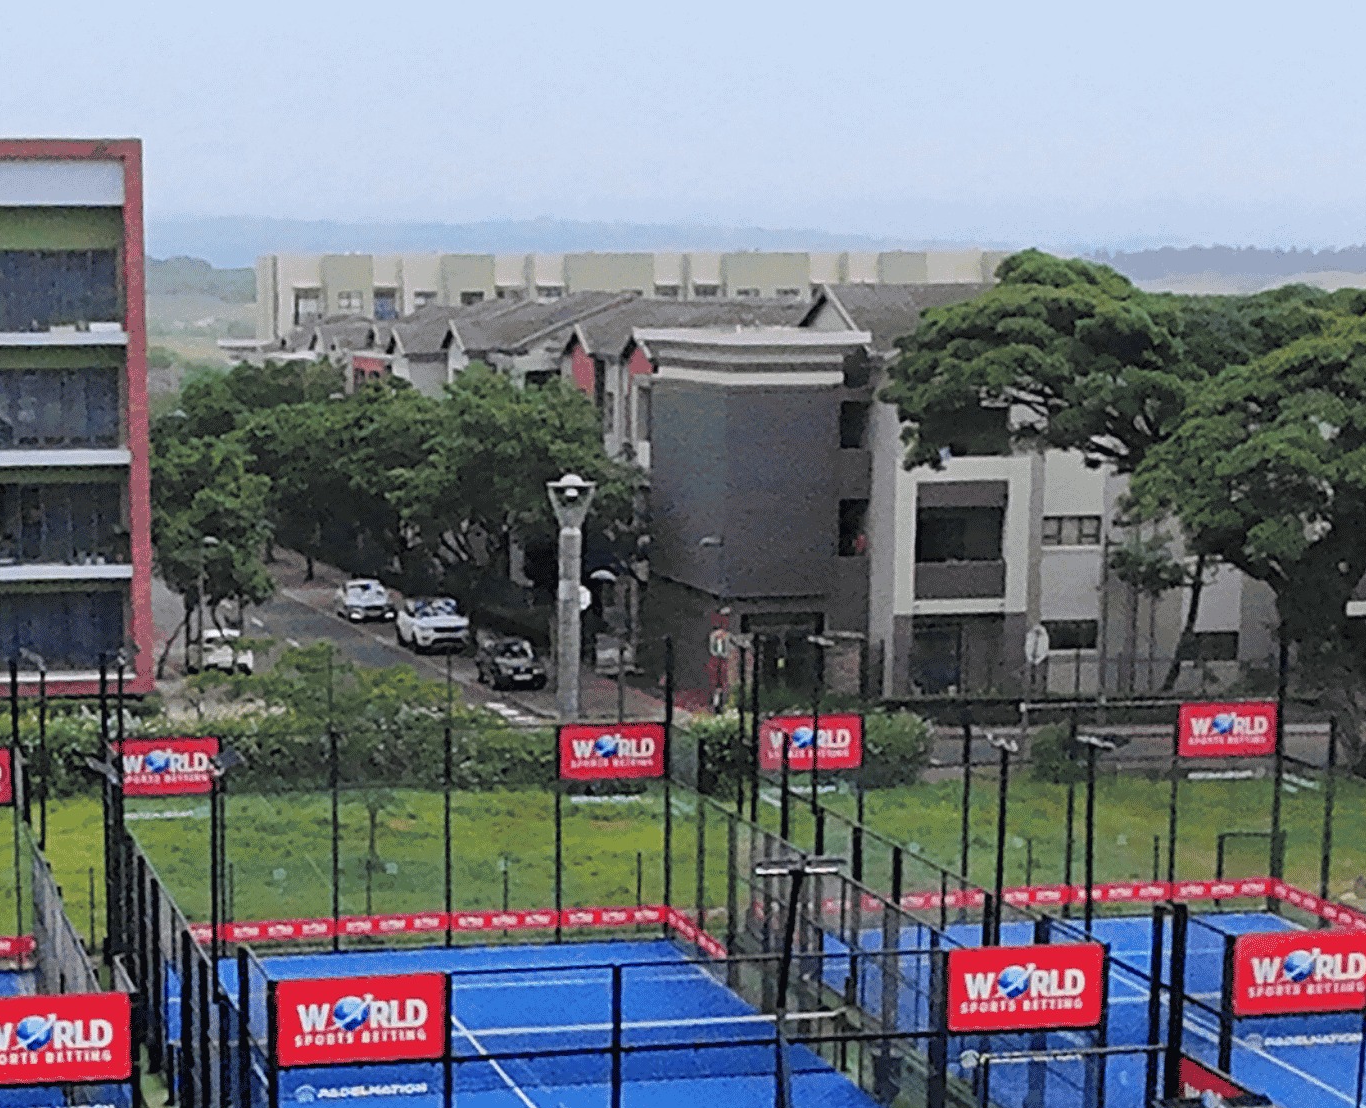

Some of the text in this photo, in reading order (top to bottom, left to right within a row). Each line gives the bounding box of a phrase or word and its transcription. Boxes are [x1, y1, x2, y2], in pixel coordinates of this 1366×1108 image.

[959, 998, 1083, 1014] SPORTS BETTING
[294, 1028, 427, 1048] SPORTS BETTING
[45, 1049, 112, 1064] BETTING
